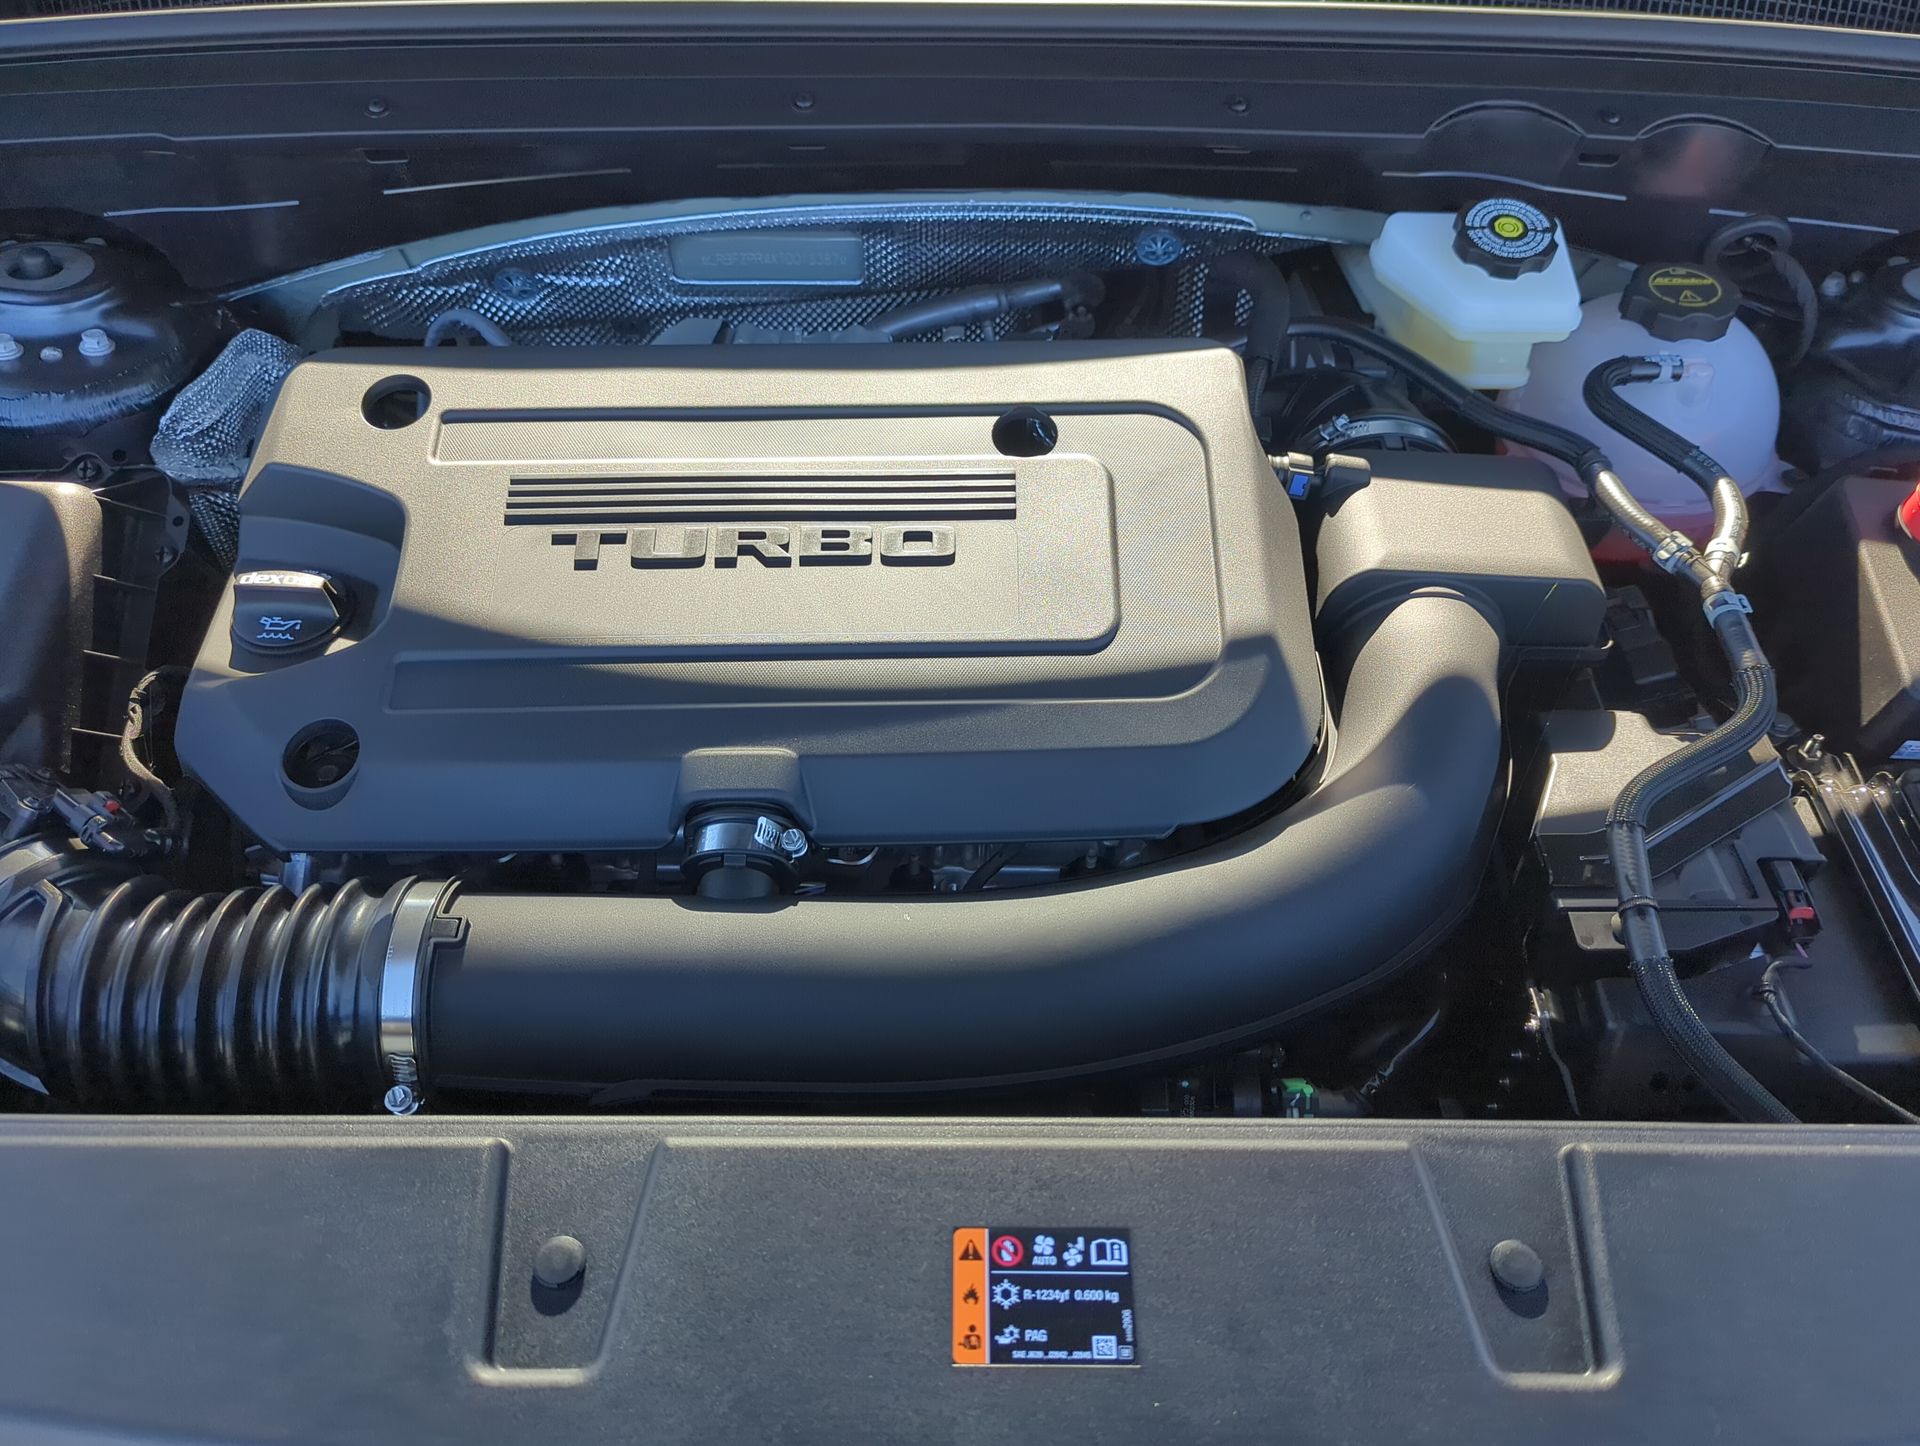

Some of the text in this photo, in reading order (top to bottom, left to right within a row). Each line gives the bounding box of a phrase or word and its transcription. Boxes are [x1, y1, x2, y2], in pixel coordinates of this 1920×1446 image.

[551, 526, 956, 571] TURBO
[1032, 1256, 1057, 1266] AUTO
[1023, 1290, 1119, 1303] R-1234yf 0.600 kg
[1025, 1329, 1048, 1342] PAG
